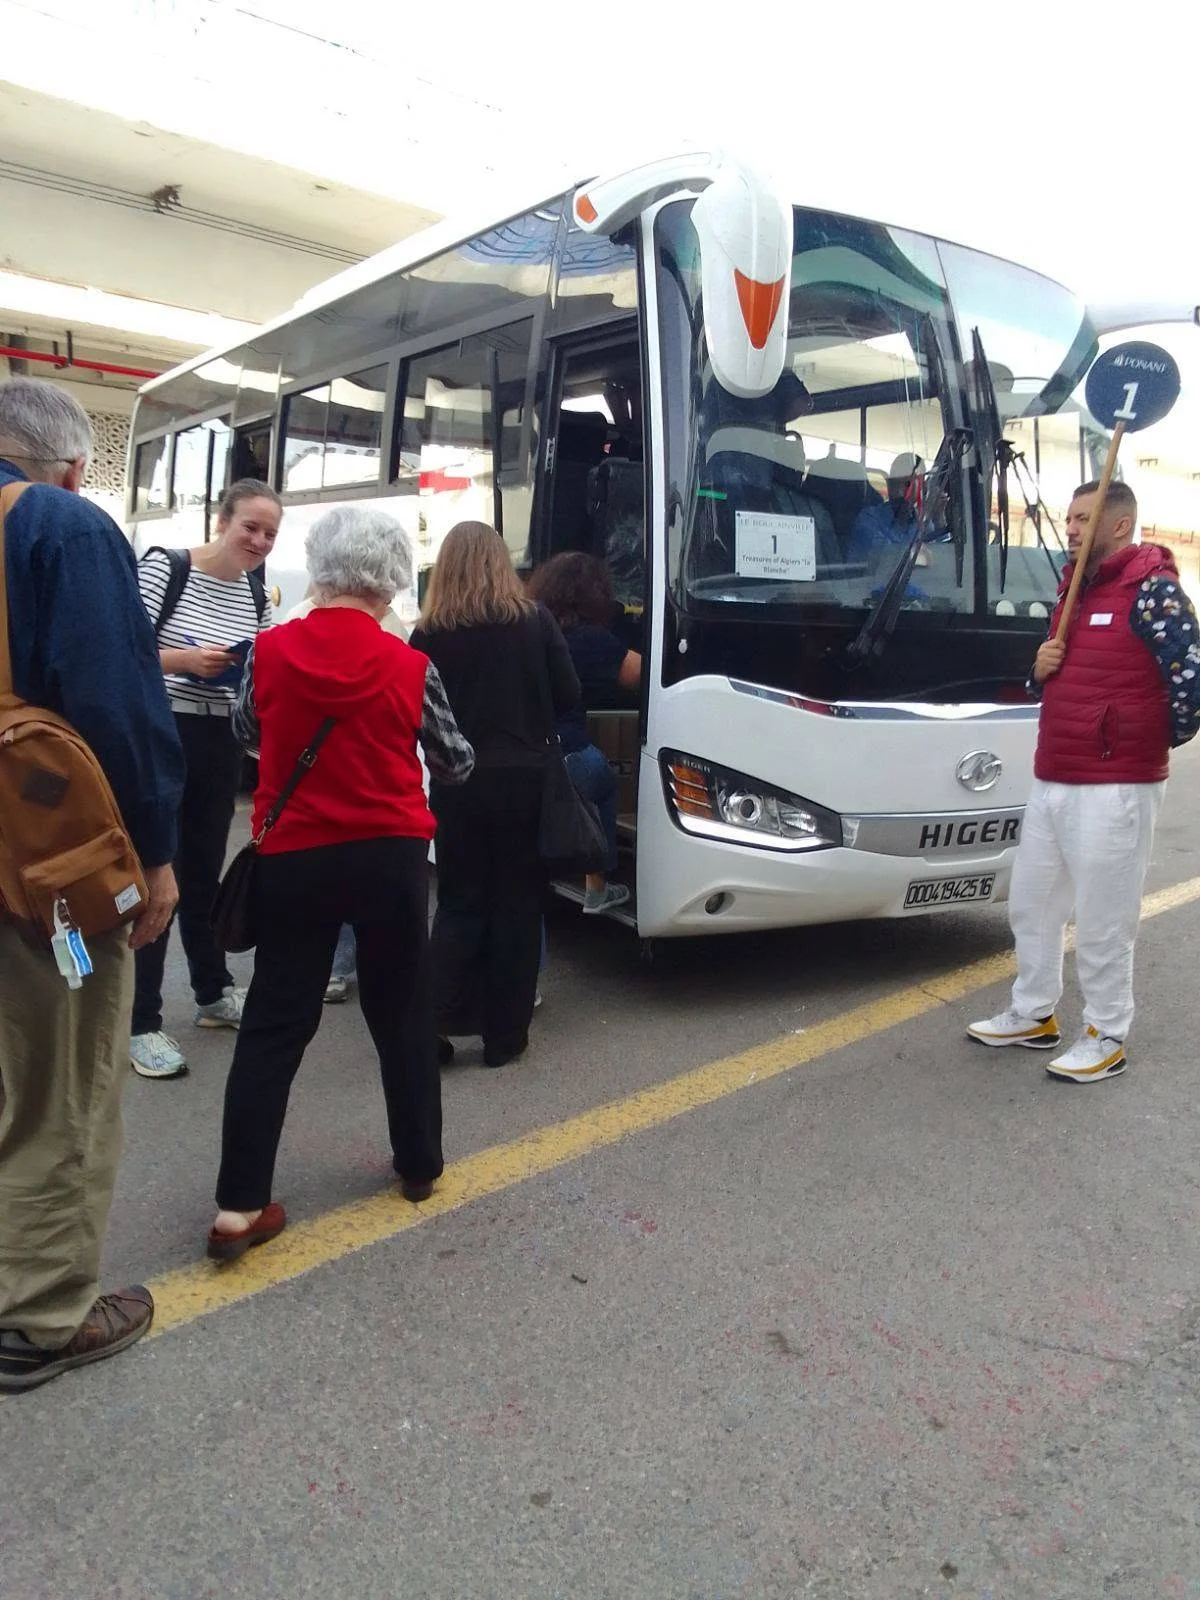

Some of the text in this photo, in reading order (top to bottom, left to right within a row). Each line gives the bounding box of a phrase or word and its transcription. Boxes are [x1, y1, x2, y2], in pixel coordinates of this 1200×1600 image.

[1124, 356, 1166, 373] PONANT
[1113, 382, 1139, 420] 1
[771, 535, 777, 555] 1
[742, 554, 772, 564] Treasures
[780, 557, 801, 566] Algiers
[919, 818, 1020, 849] HIGER
